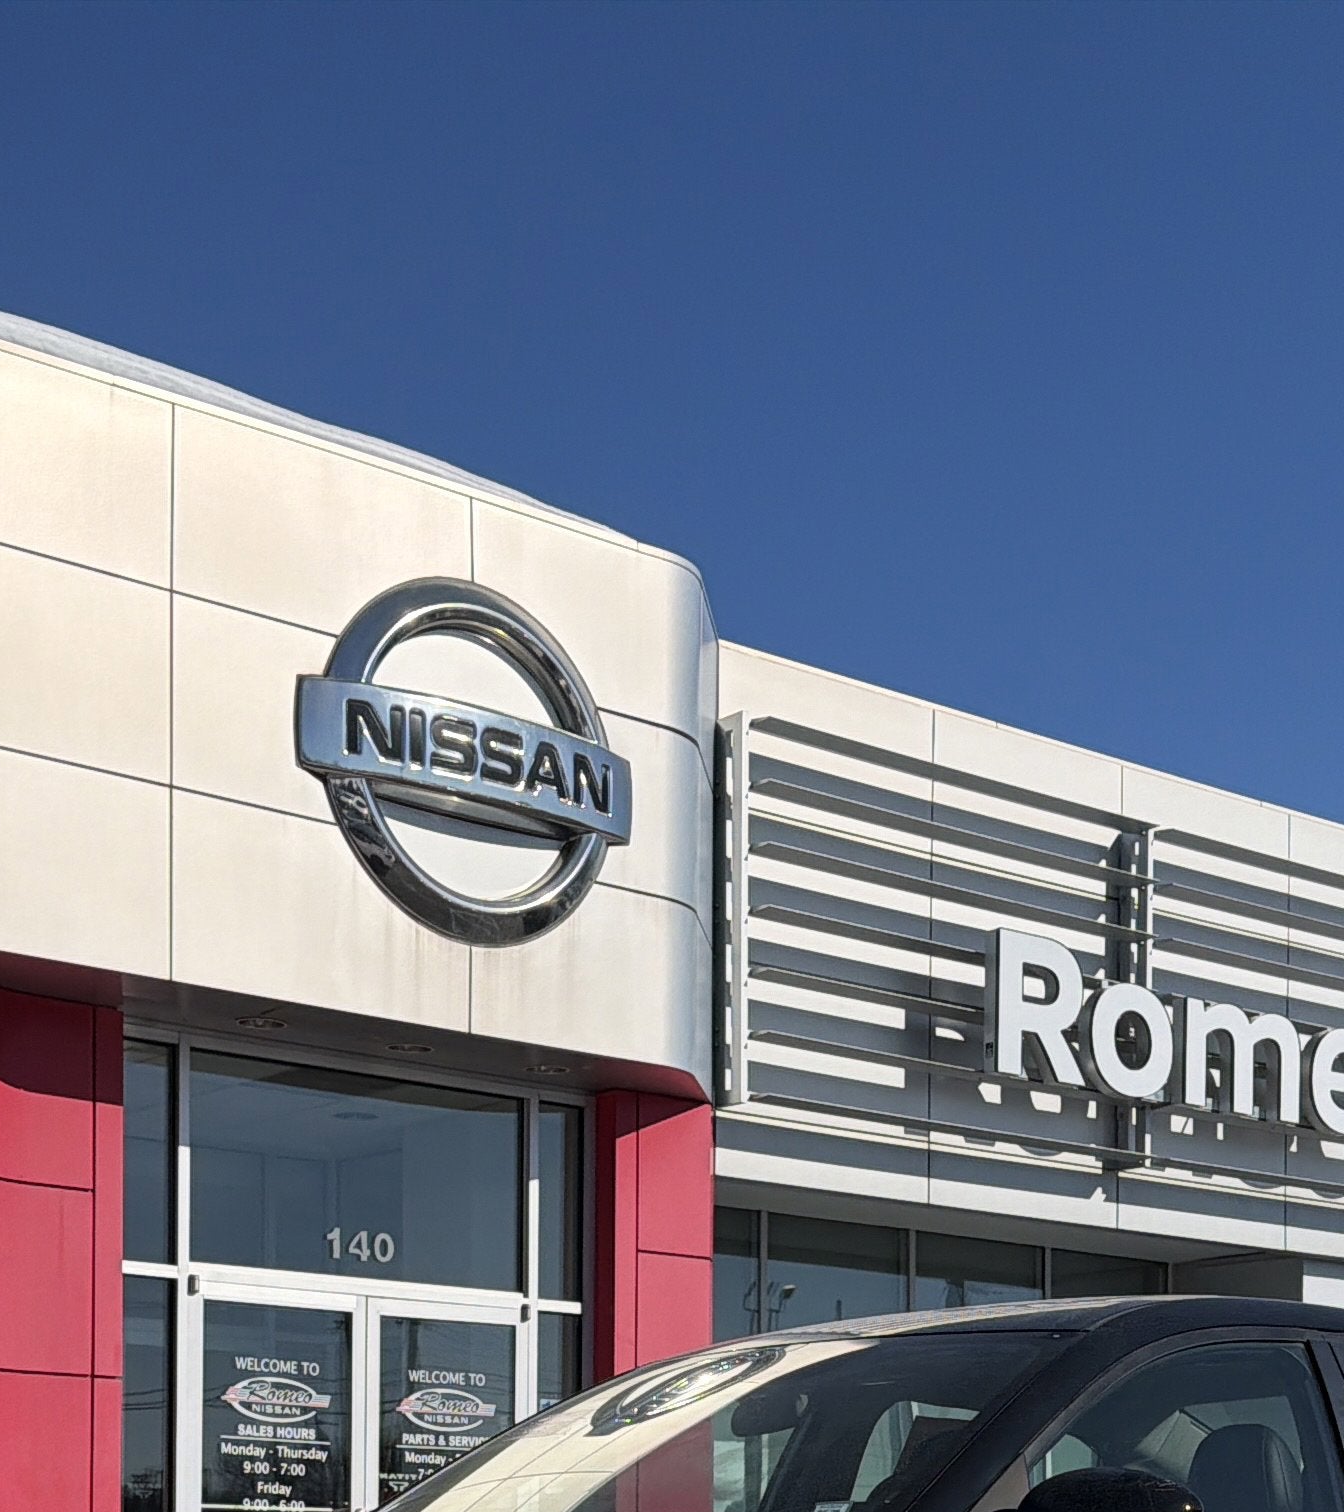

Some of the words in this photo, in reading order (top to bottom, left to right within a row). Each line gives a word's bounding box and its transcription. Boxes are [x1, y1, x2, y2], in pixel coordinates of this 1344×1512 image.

[344, 698, 613, 818] NISSAN
[326, 1226, 395, 1263] 140
[235, 1356, 298, 1375] WELCOME
[301, 1361, 320, 1376] TO
[408, 1369, 466, 1385] WELCOME
[468, 1373, 486, 1387] TO
[247, 1380, 313, 1404] Romeo
[251, 1403, 301, 1416] NISSAN
[416, 1392, 480, 1414] Romeo
[423, 1414, 469, 1425] NISSAN
[237, 1423, 274, 1438] SALES
[276, 1427, 316, 1440] HOURS
[402, 1432, 435, 1446] PARTS
[438, 1434, 446, 1446] &
[220, 1441, 266, 1459] Monday
[276, 1445, 329, 1463] Thursday
[404, 1450, 447, 1467] Monday
[243, 1460, 270, 1475] 9:00
[280, 1462, 306, 1476] 7:00
[257, 1482, 292, 1498] Friday
[242, 1498, 269, 1511] 9:00
[279, 1500, 306, 1512] 6:00
